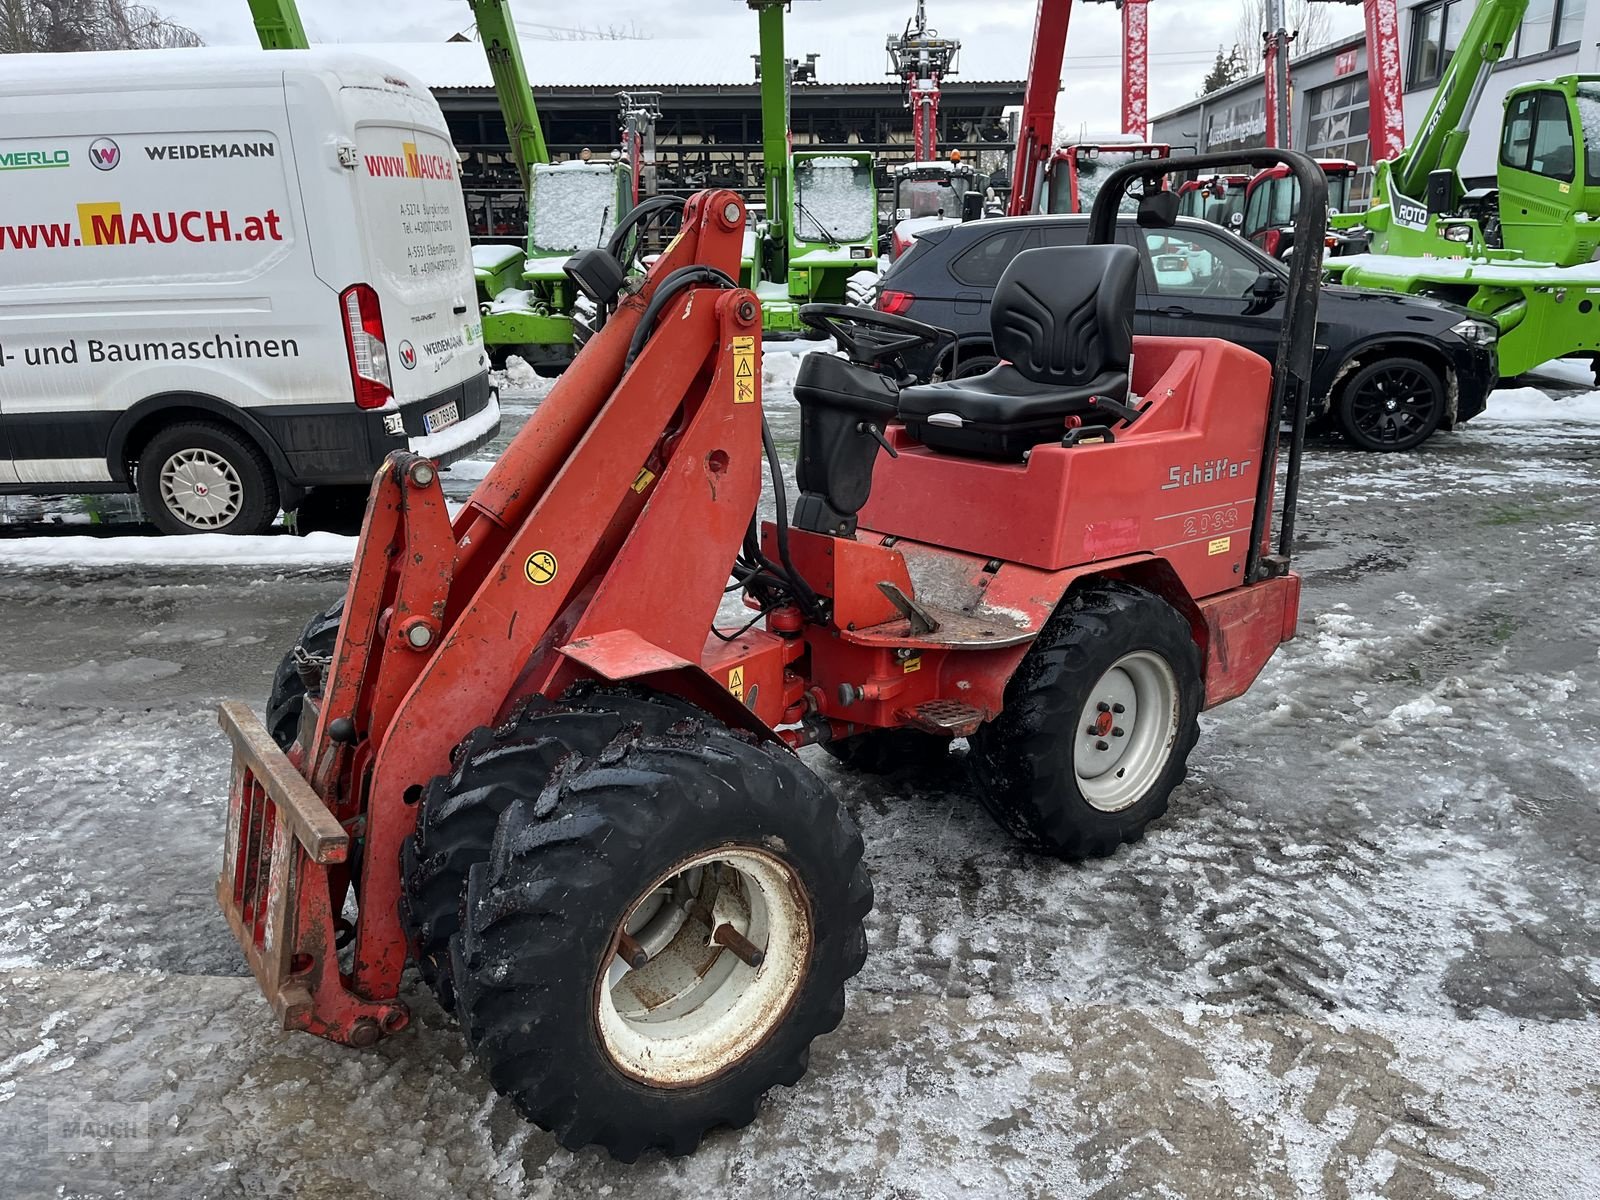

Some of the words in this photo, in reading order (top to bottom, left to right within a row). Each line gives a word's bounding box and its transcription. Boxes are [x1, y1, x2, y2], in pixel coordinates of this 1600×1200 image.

[0, 150, 69, 166] MERLO
[145, 143, 274, 160] WEIDEMANN
[1399, 204, 1428, 224] ROTO
[24, 340, 78, 367] und
[87, 334, 299, 363] Baumaschinen
[422, 335, 464, 356] WEIDEMANN
[1183, 507, 1238, 537] 2033
